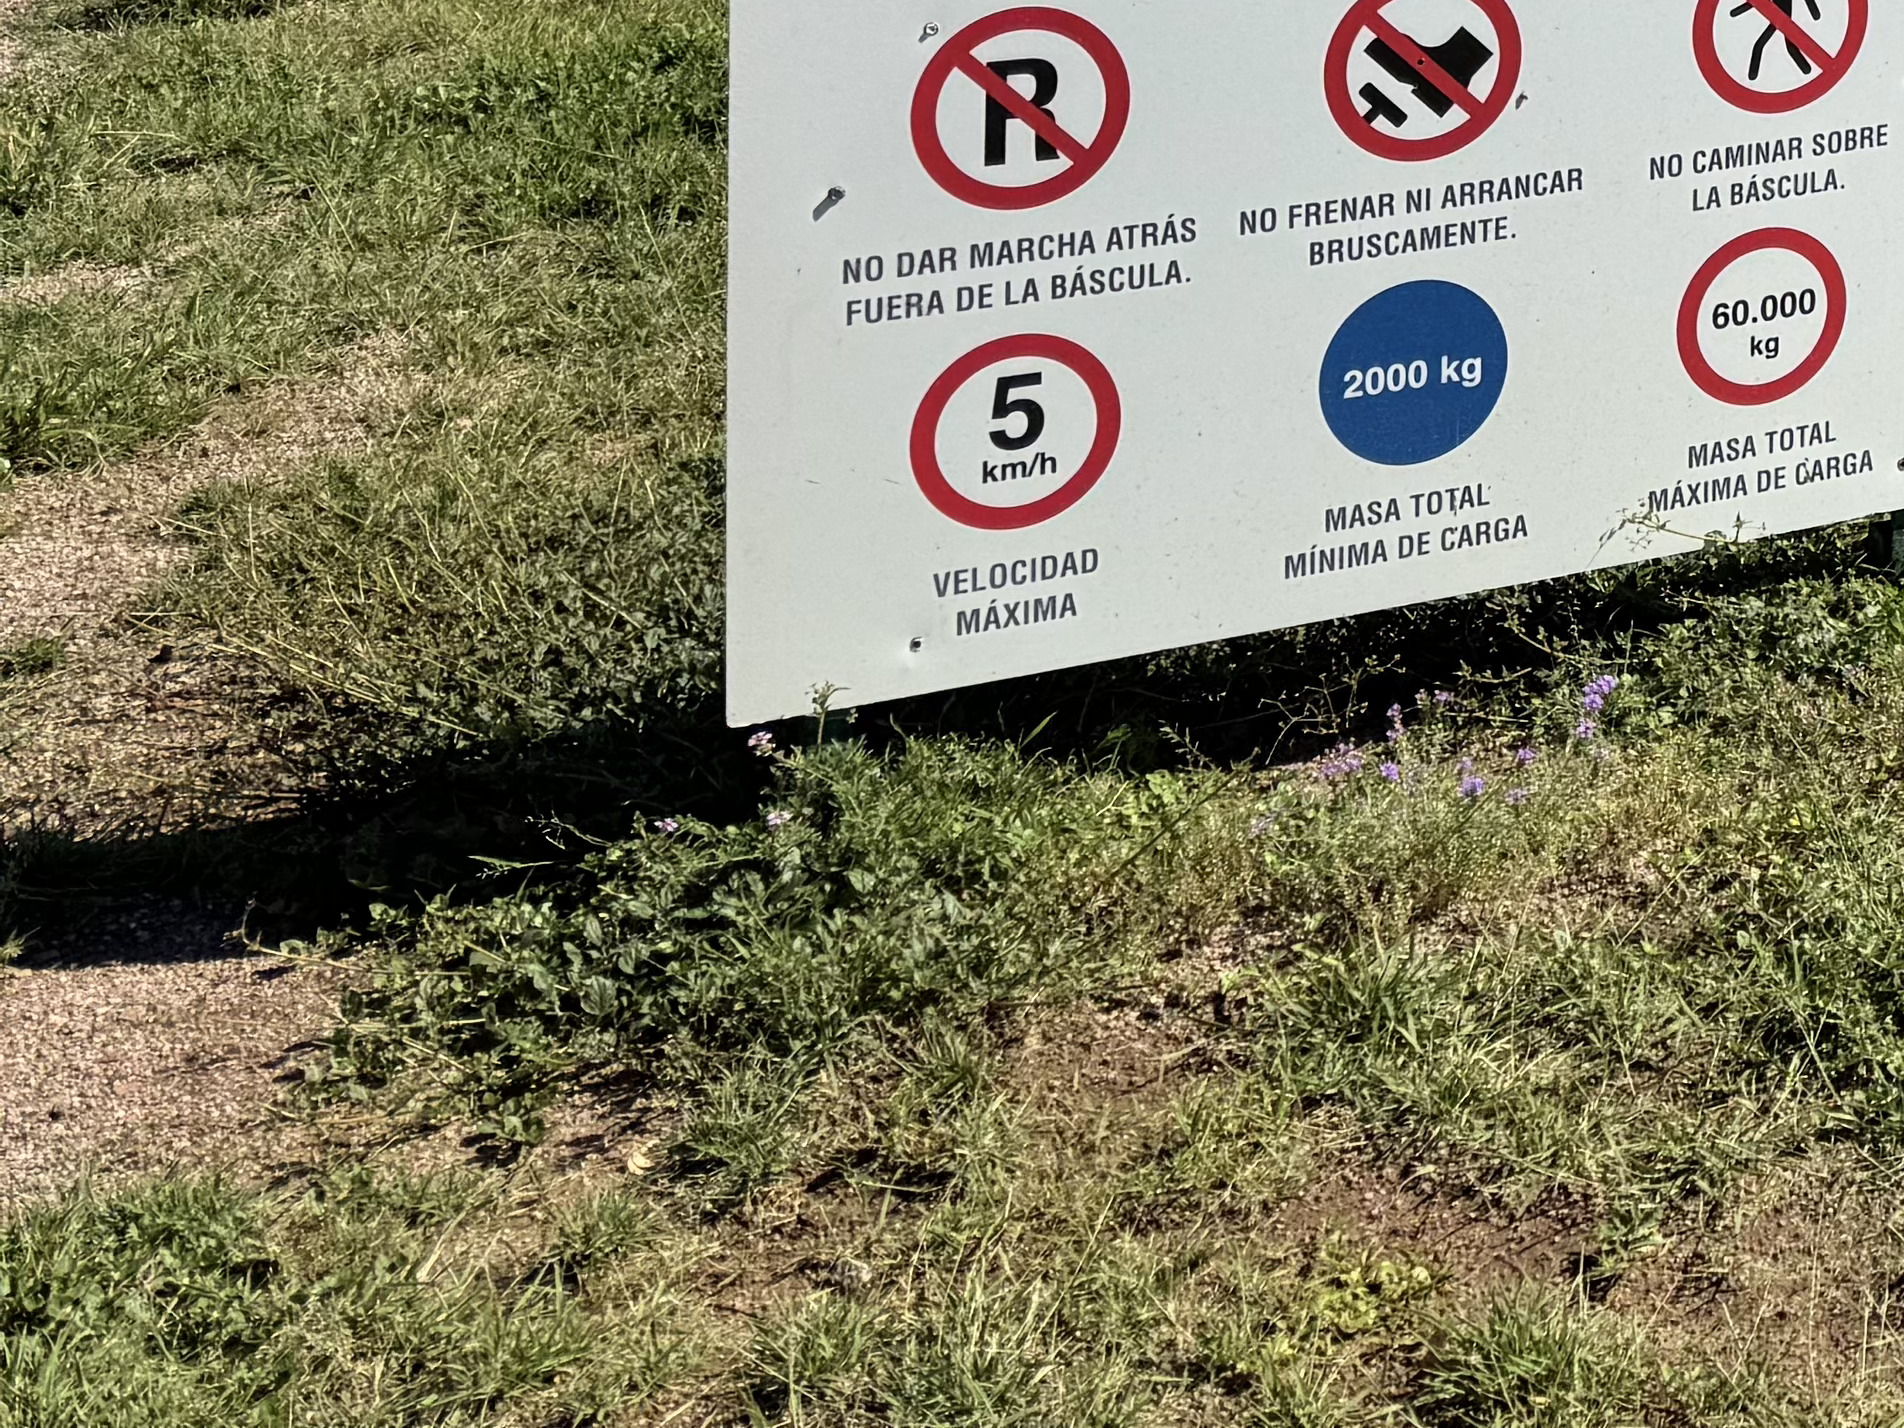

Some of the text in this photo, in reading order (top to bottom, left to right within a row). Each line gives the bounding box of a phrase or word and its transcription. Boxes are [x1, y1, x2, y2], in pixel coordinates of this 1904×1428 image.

[1650, 124, 1888, 180] NO CAMINAR SOBRE
[1240, 168, 1582, 235] NO FRENAR NI ARRANCAR
[1693, 169, 1844, 211] LA BÁSCULA.
[843, 214, 1196, 284] NO DAR MARCHA ATRÁS
[1310, 216, 1515, 266] BRUSCAMENTE.
[847, 260, 1190, 326] FUERA DE LA BÁSCULA.
[1713, 289, 1815, 329] 60.000
[1751, 336, 1779, 359] kg
[1344, 356, 1481, 398] 2000 kg
[989, 372, 1044, 450] 5
[983, 452, 1056, 483] km/h
[1689, 421, 1836, 468] MASA TOTAL
[1648, 450, 1872, 510] MÁXIMA DE CARGA
[1326, 483, 1490, 532] MASA TOTAL
[1285, 515, 1527, 579] MÍNIMA DE CARGA
[933, 549, 1098, 597] VELOCIDAD
[957, 593, 1076, 636] MÁXIMA
